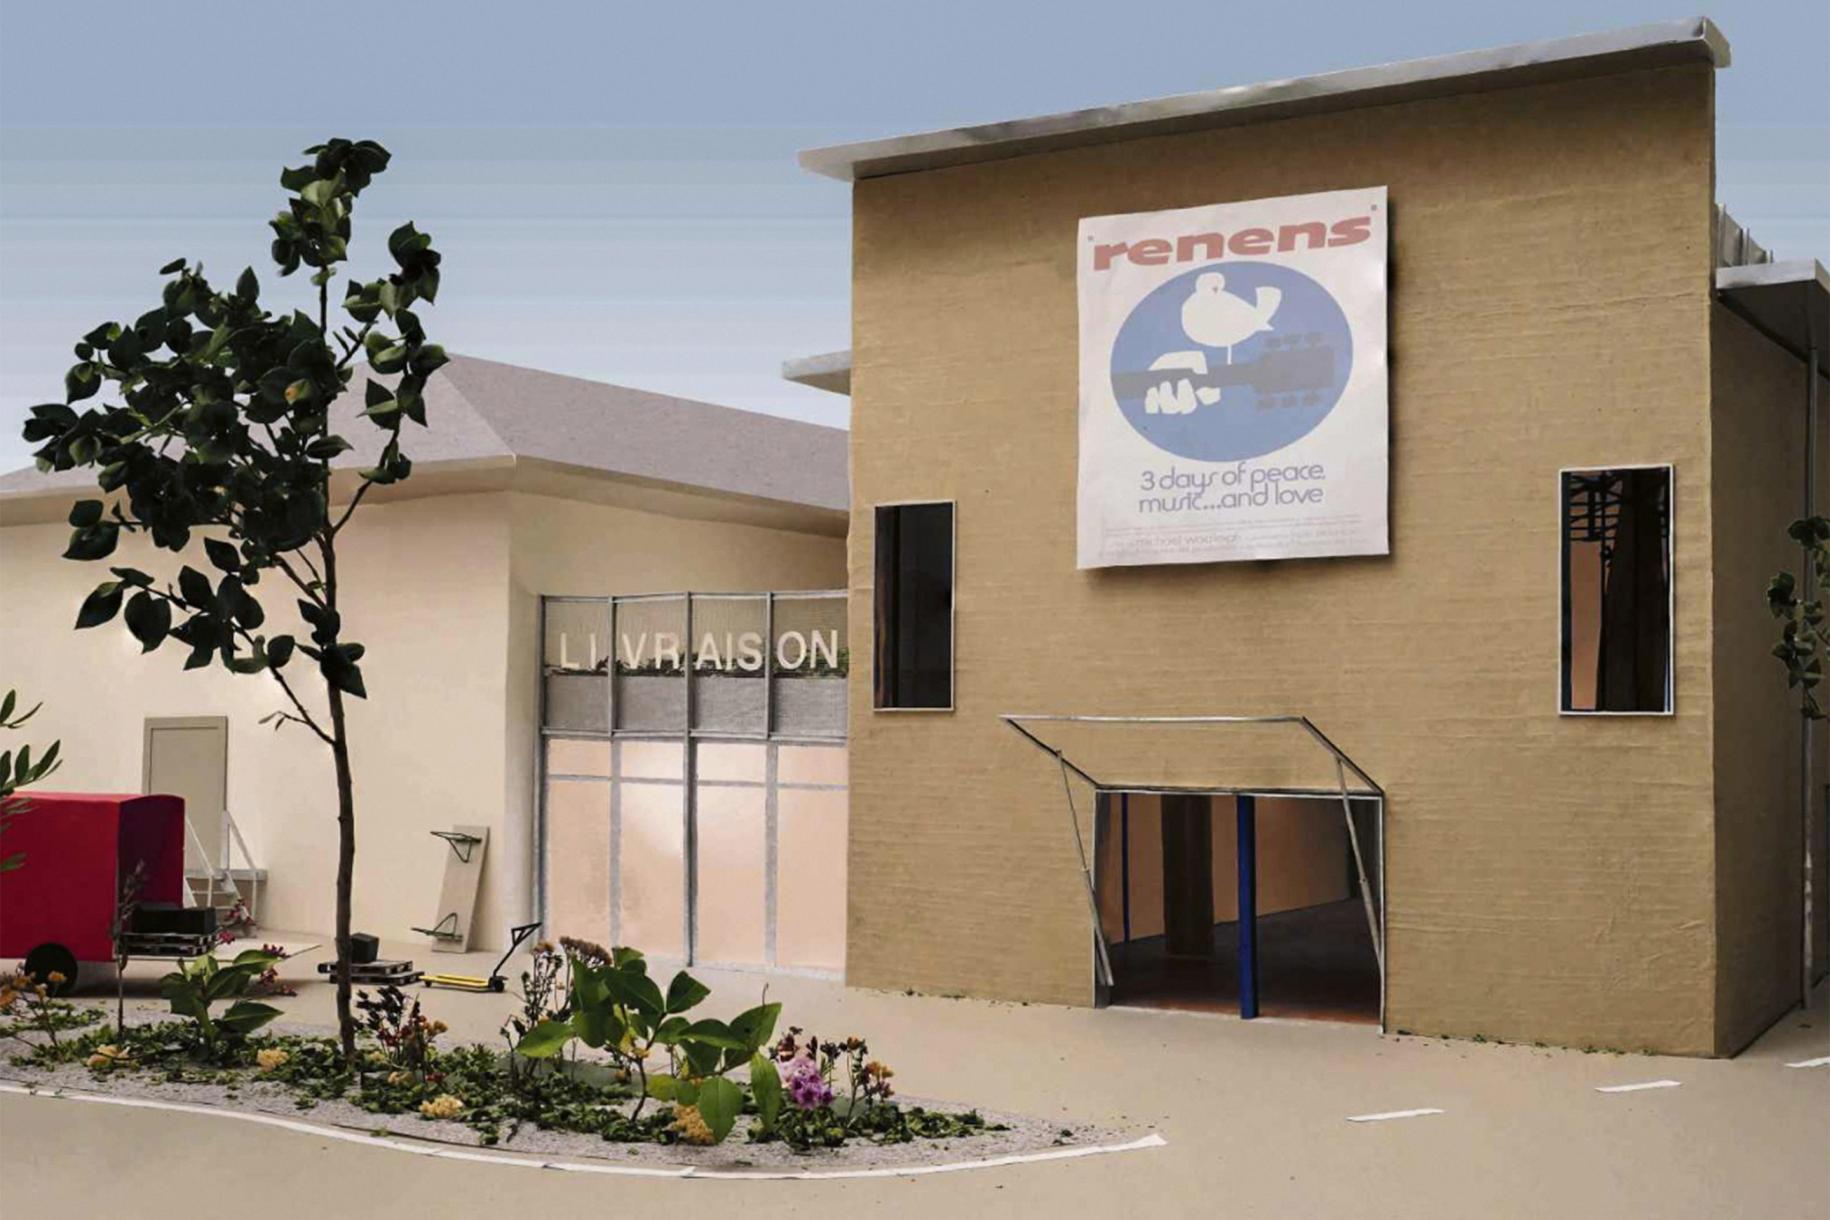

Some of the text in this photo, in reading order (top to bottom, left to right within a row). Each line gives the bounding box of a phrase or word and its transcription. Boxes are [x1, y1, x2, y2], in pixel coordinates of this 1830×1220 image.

[1093, 216, 1371, 271] renens
[1140, 470, 1155, 491] 3
[1159, 466, 1218, 495] days
[1221, 462, 1247, 486] of
[1275, 481, 1324, 505] love
[559, 629, 839, 671] LIVRAISON
